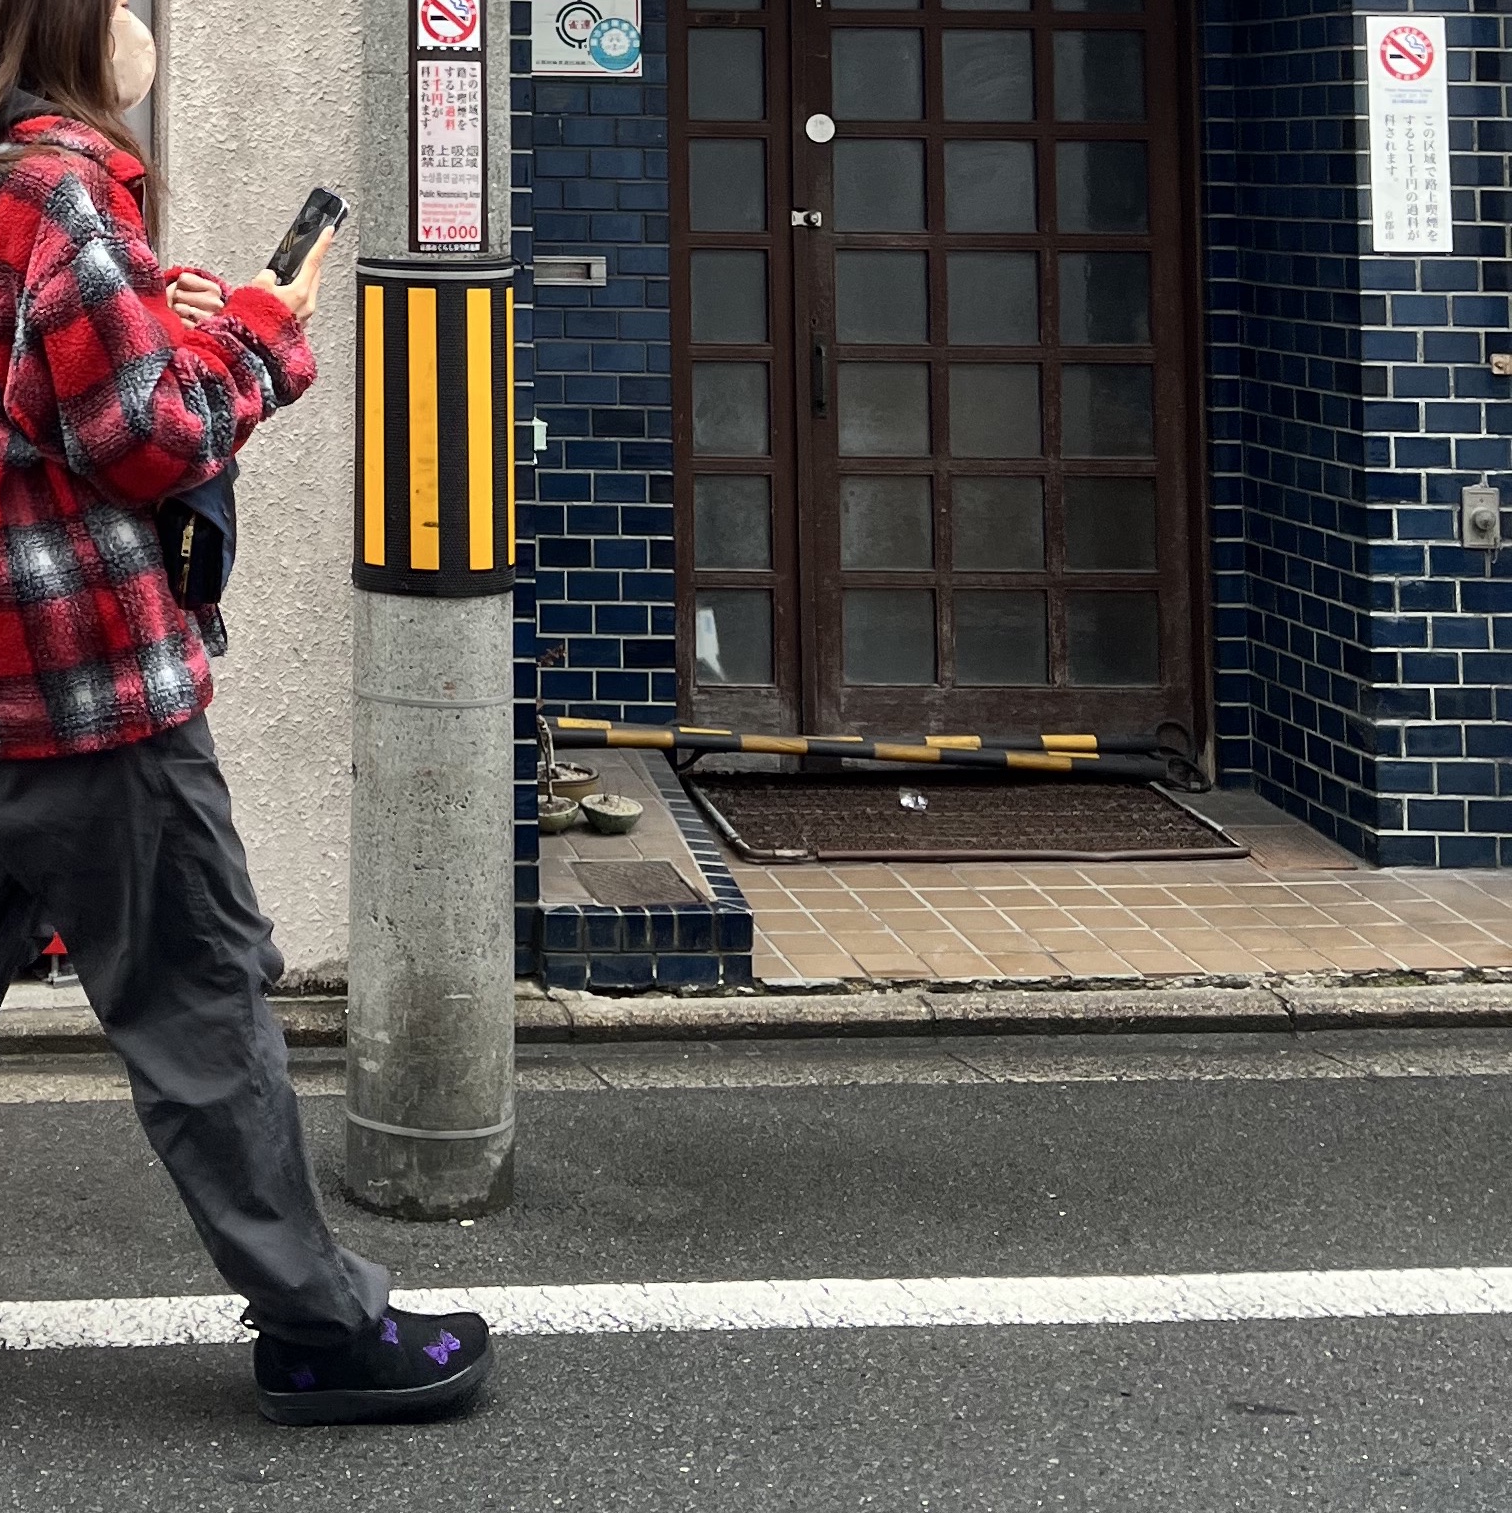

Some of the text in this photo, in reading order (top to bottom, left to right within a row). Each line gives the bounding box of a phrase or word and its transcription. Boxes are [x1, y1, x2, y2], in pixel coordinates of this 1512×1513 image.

[469, 67, 479, 128] この区域で
[421, 157, 479, 168] 禁止区域
[1385, 114, 1399, 183] 科されます。
[1403, 115, 1419, 241] すると1千円の過料が
[1423, 115, 1438, 242] この区域で路上喫煙を
[422, 225, 478, 239] ¥1,000
